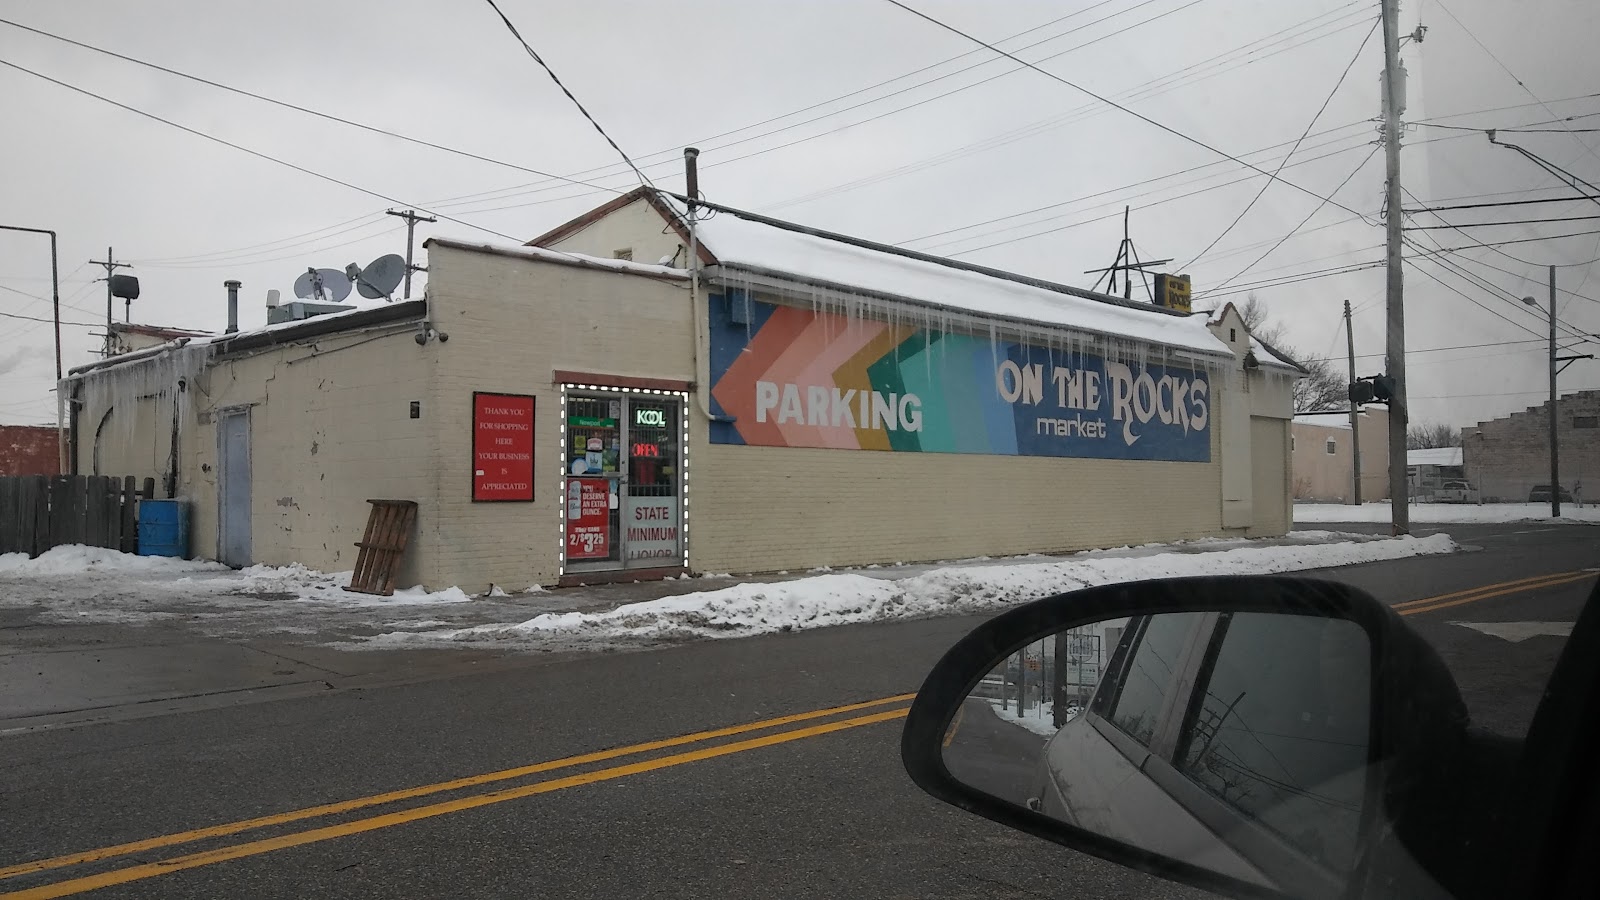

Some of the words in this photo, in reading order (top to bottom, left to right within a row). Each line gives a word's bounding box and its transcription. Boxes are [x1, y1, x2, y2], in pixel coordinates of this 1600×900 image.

[756, 380, 923, 433] PARKING
[998, 359, 1044, 407] ON
[1052, 366, 1101, 411] THE
[1105, 361, 1208, 447] ROCKS
[484, 407, 509, 415] THANK
[510, 408, 525, 416] YOU
[636, 410, 666, 425] KOOL
[479, 422, 494, 430] FOR
[494, 423, 529, 431] SHOPPING
[579, 419, 601, 427] Newport
[1036, 413, 1107, 439] market
[478, 452, 498, 460] YOUR
[498, 453, 530, 461] BUSINESS
[631, 443, 659, 457] OPEN
[635, 506, 669, 520] STATE
[627, 527, 677, 541] MINIMUM
